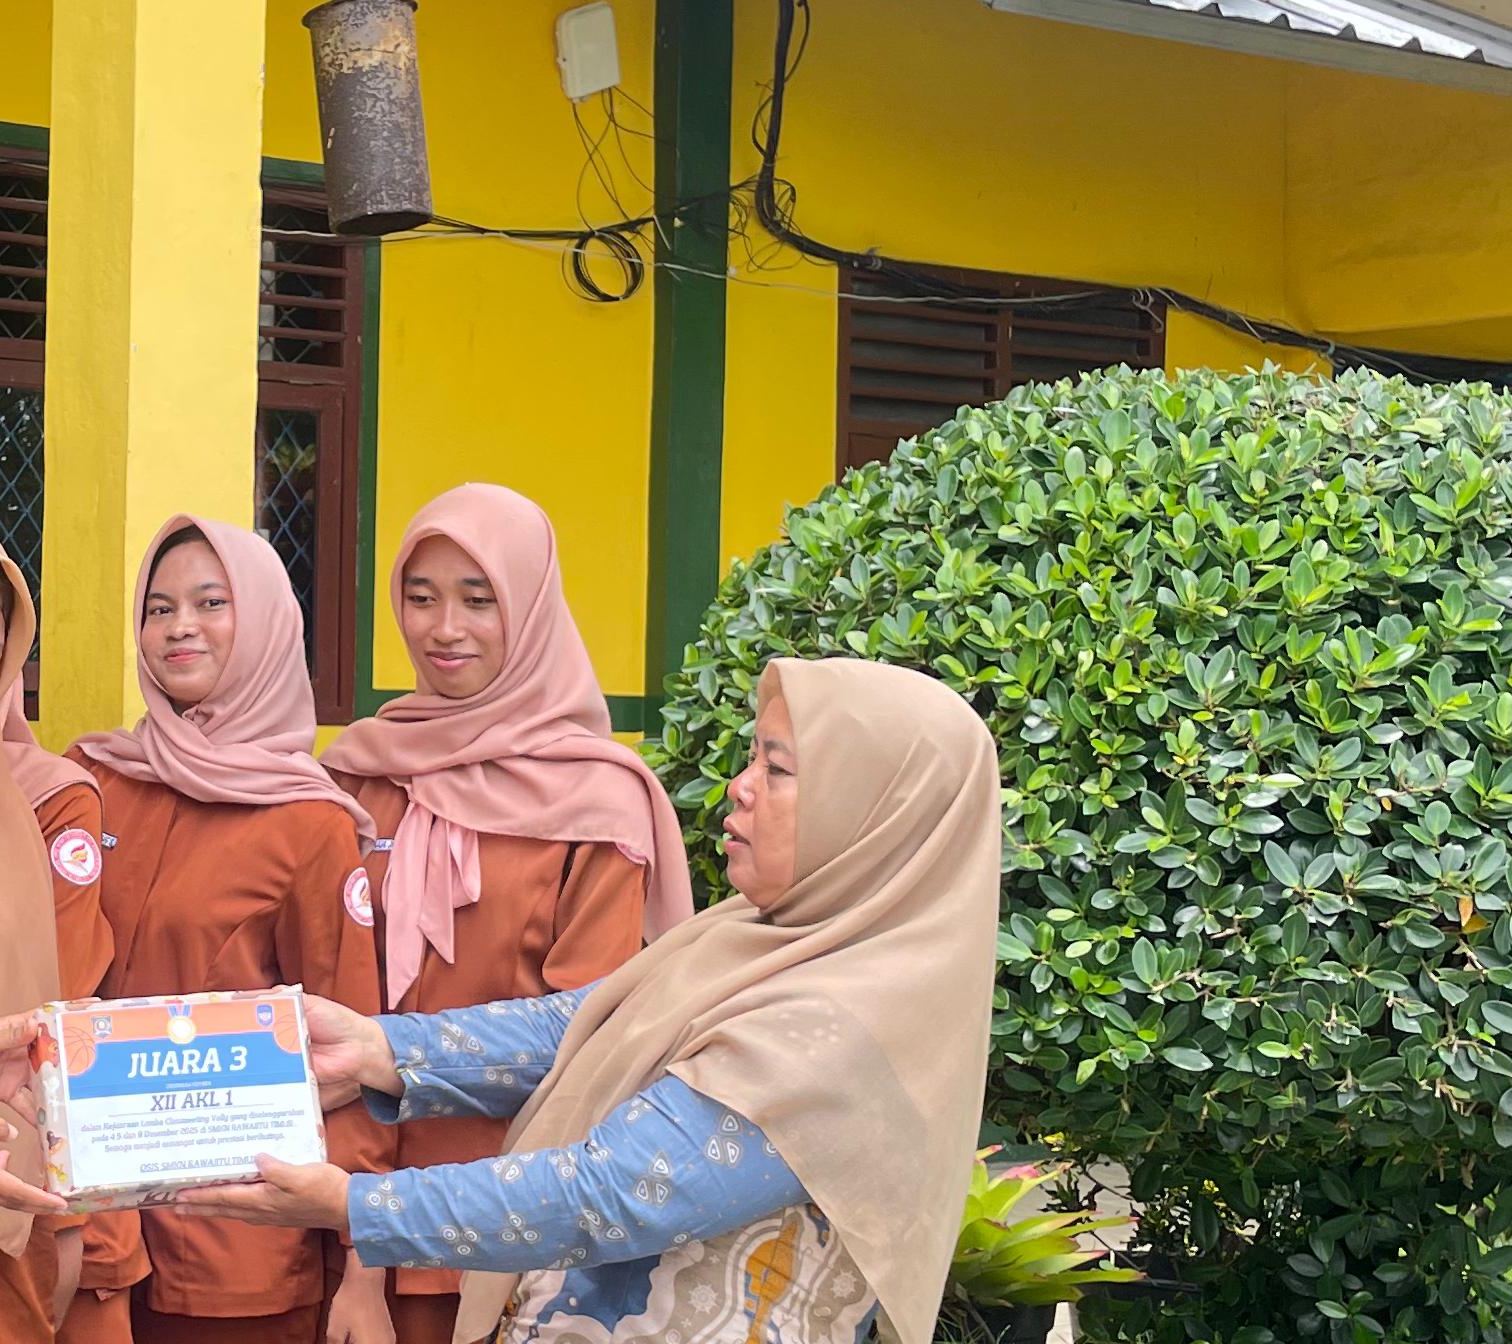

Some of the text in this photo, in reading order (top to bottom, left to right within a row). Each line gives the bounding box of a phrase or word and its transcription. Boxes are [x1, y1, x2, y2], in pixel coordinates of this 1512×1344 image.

[127, 1045, 248, 1078] JUARA 3
[150, 1089, 233, 1112] XII AKL 1
